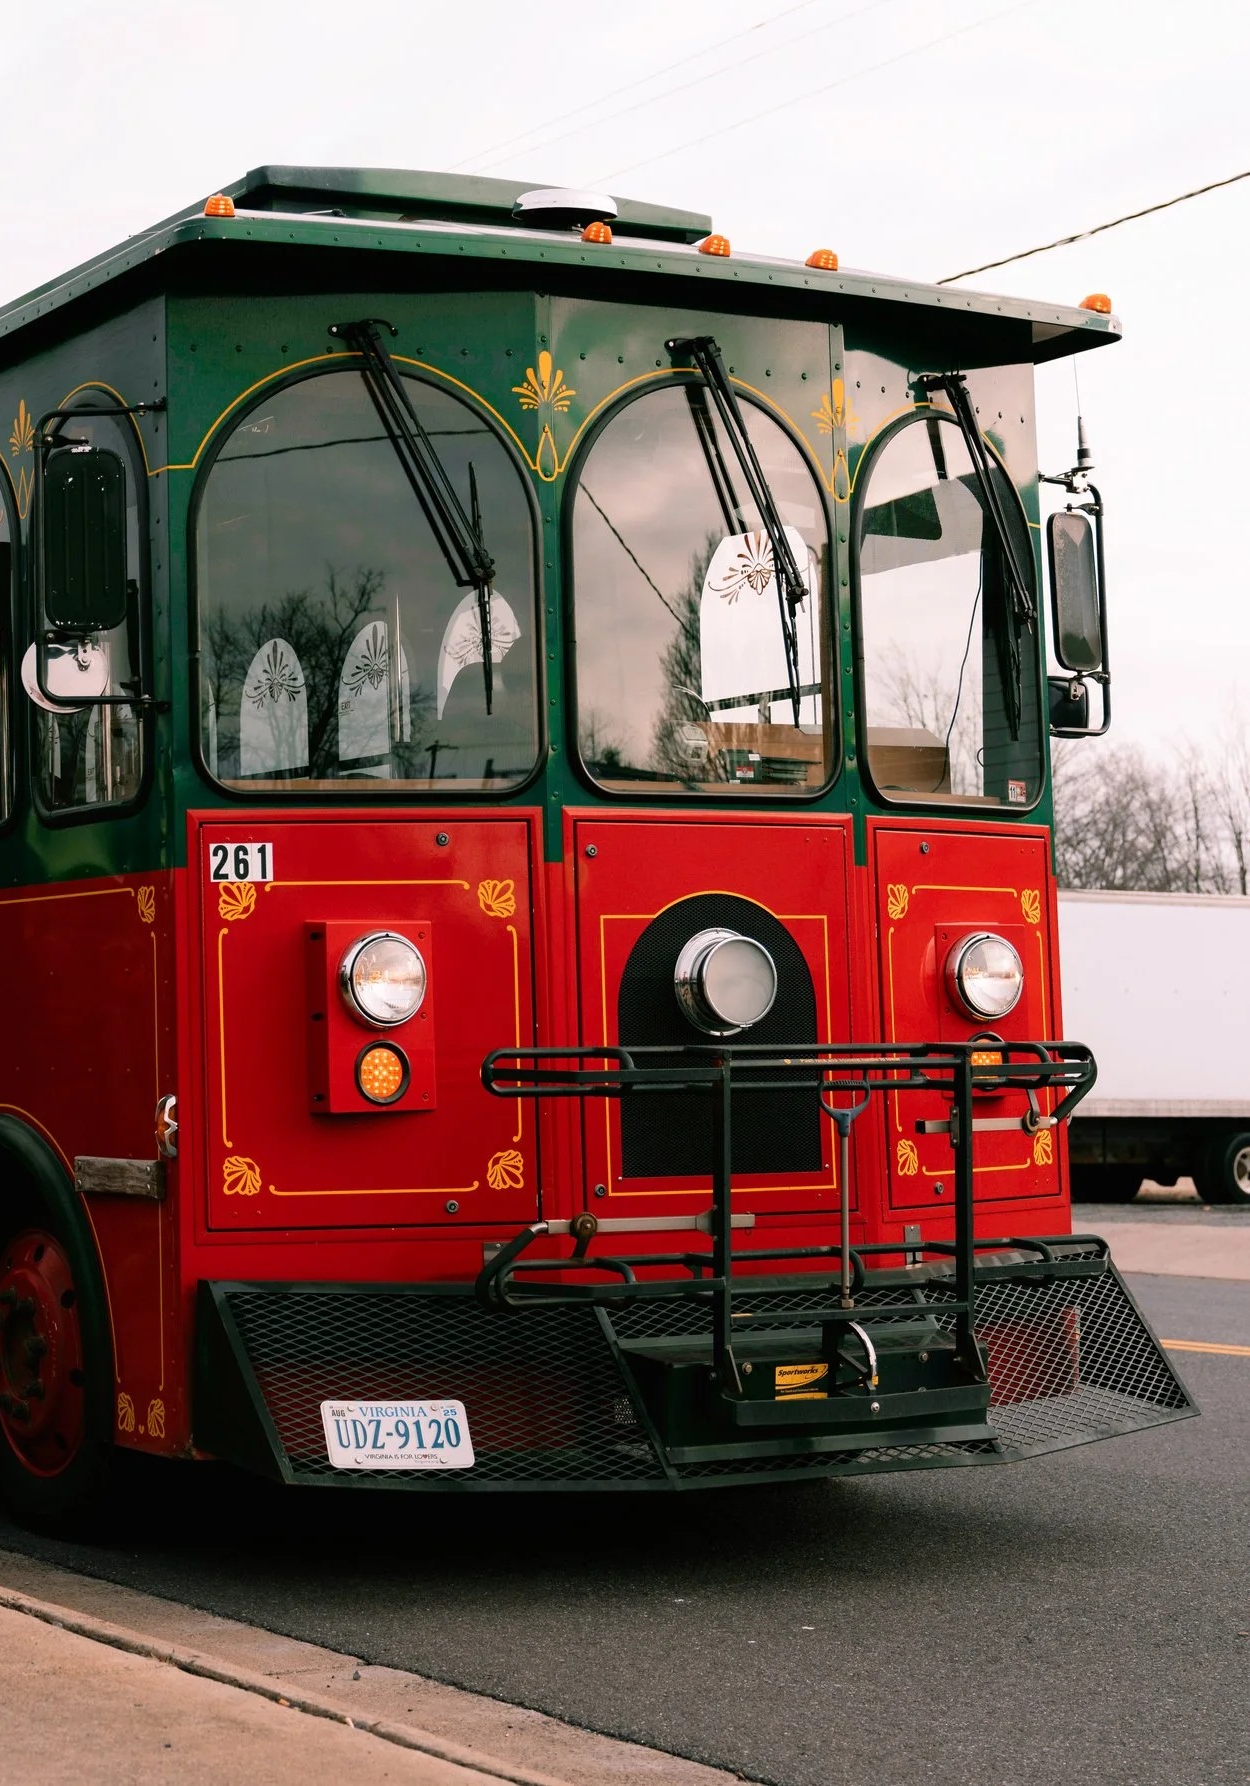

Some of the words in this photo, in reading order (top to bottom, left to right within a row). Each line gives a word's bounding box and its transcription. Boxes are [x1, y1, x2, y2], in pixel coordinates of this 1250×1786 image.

[212, 844, 267, 880] 261
[778, 1367, 819, 1377] Sportworks
[331, 1409, 346, 1417] AUG
[358, 1406, 428, 1418] VIRGINIA
[334, 1418, 461, 1449] UDZ-9120
